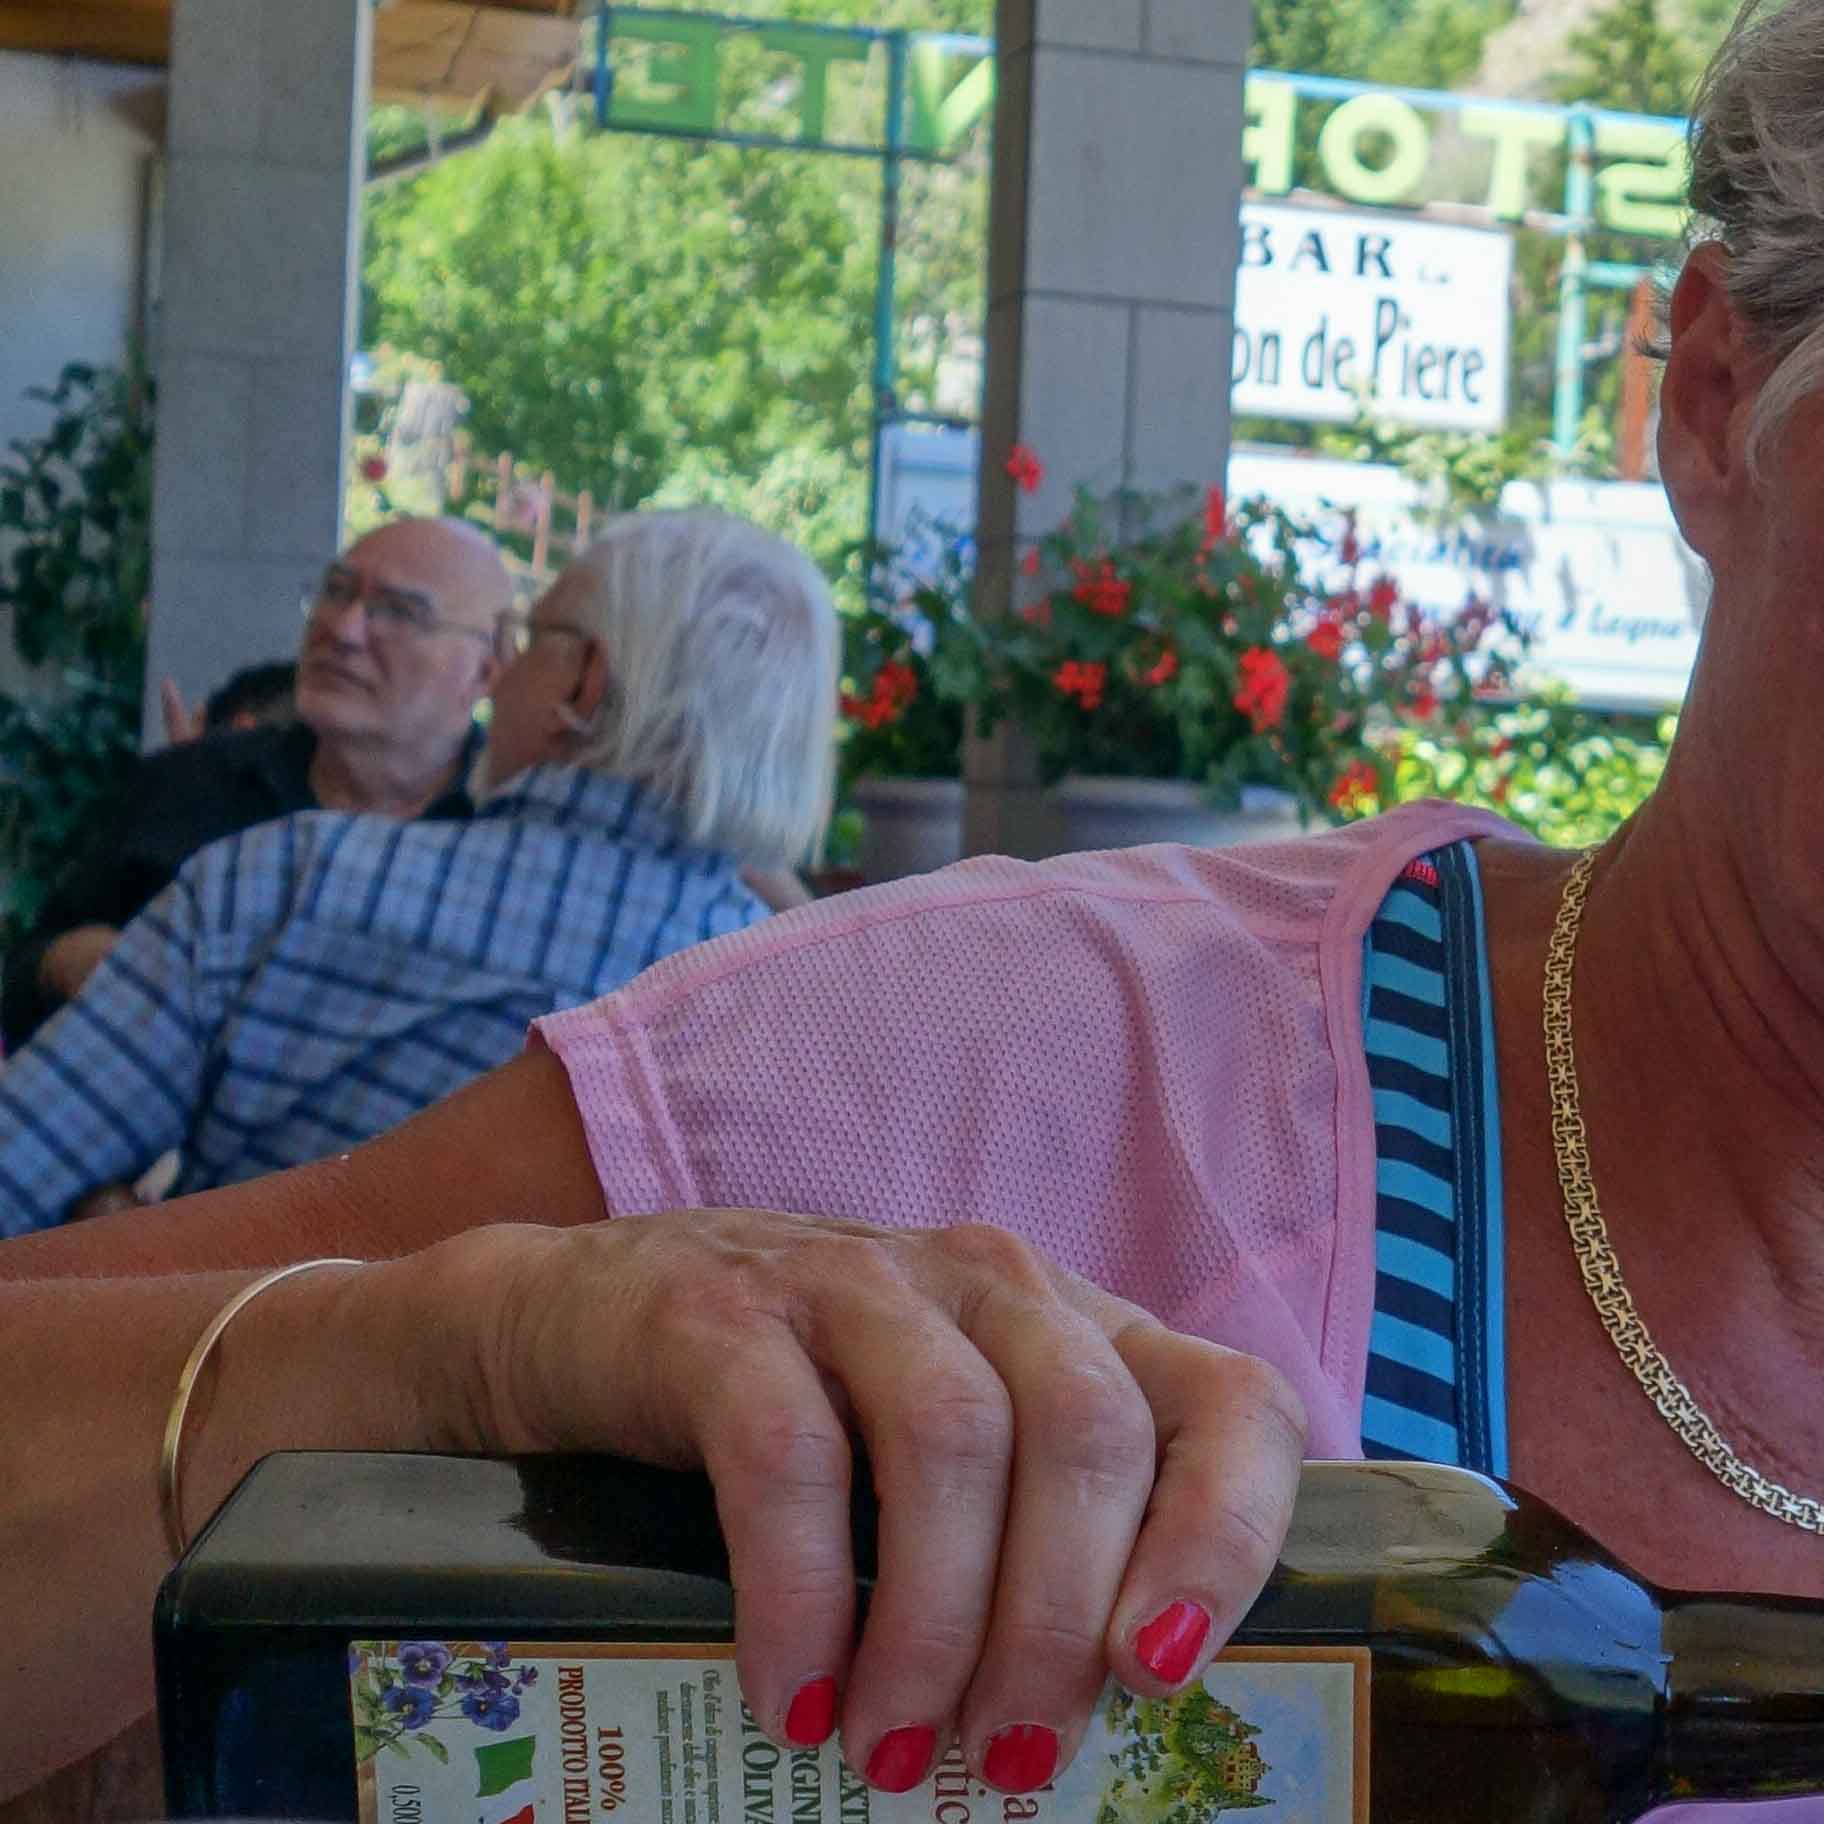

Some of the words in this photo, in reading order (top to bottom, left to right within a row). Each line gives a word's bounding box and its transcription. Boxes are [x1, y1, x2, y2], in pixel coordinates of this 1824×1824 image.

[1241, 222, 1394, 278] BAR
[1232, 326, 1282, 388] on
[1302, 314, 1356, 393] de
[1371, 295, 1486, 404] Piere
[558, 1664, 589, 1773] PRODOTTO
[597, 1726, 627, 1811] 100%
